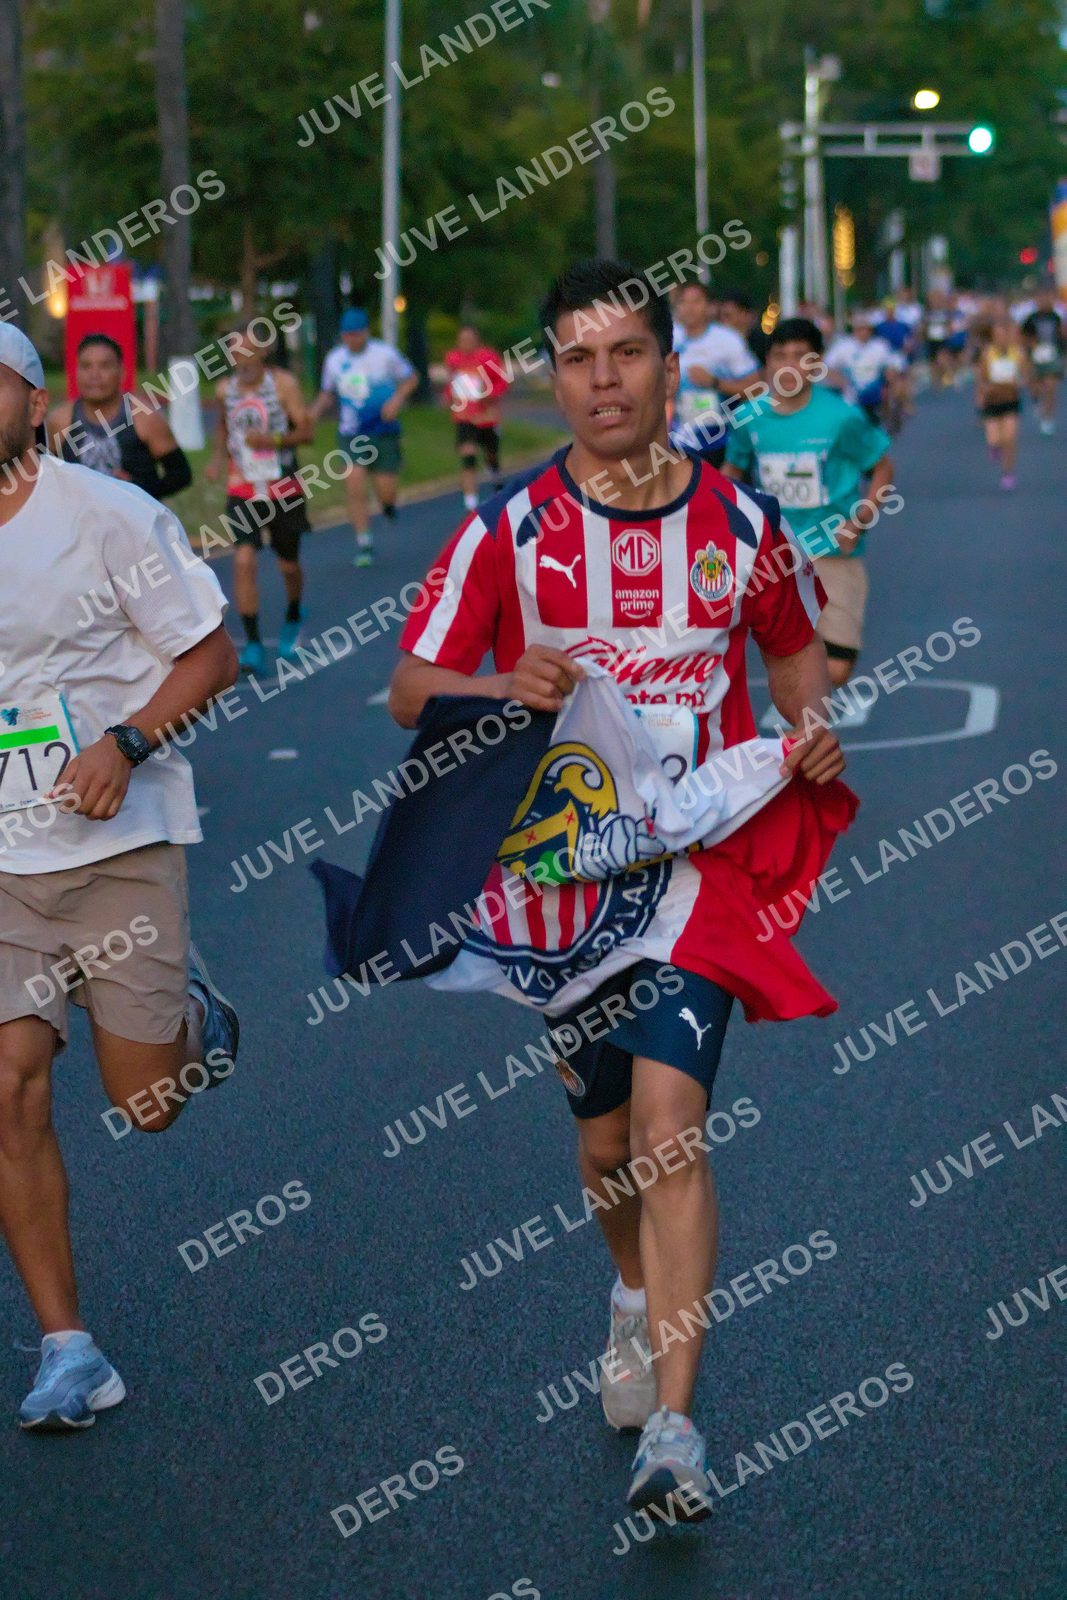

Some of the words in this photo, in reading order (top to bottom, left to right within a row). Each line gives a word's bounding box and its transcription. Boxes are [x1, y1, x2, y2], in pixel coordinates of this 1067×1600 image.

[617, 533, 656, 571] MG
[615, 589, 659, 599] amazon
[620, 599, 655, 612] prime
